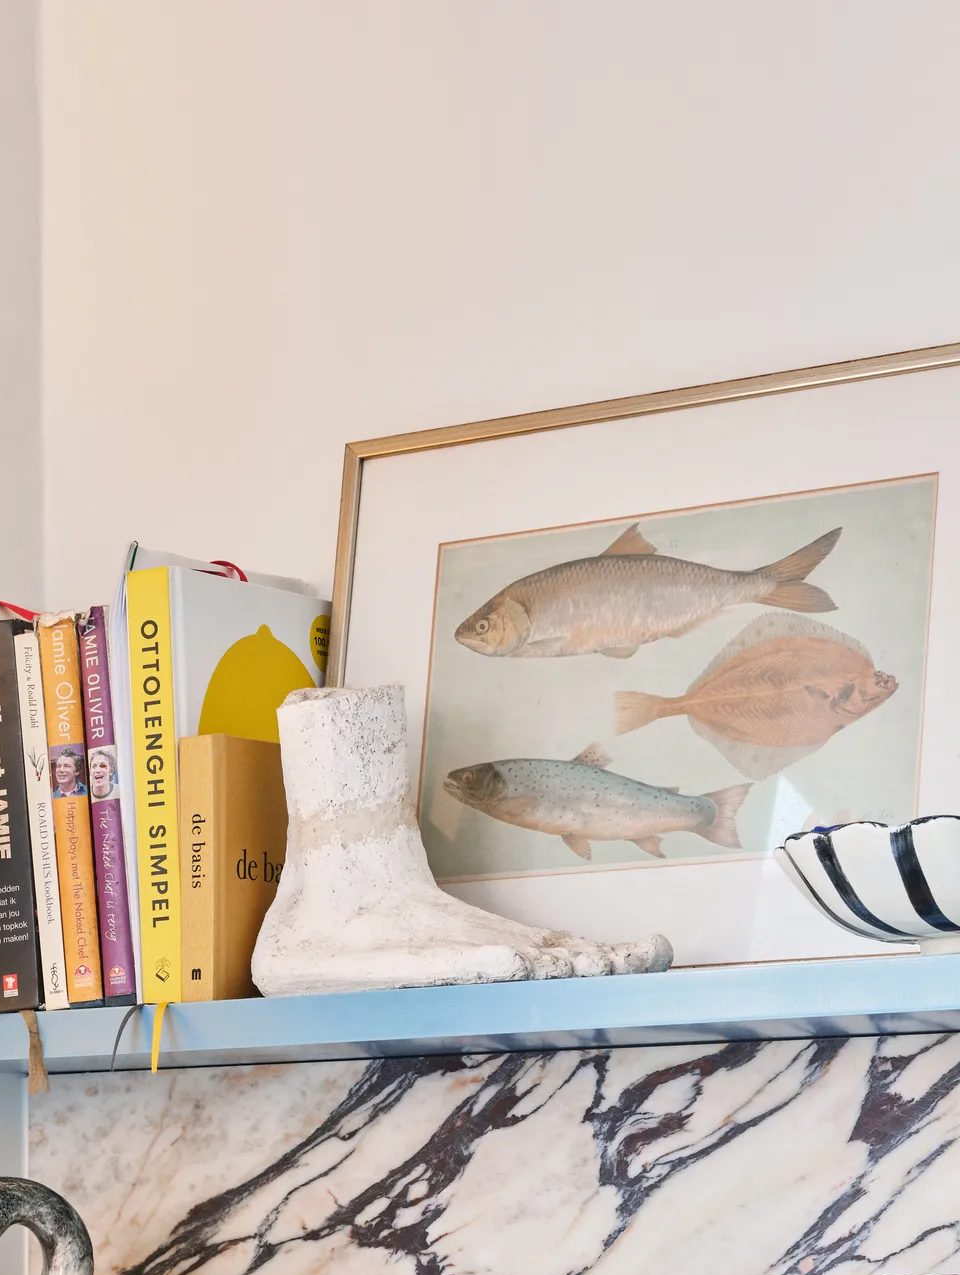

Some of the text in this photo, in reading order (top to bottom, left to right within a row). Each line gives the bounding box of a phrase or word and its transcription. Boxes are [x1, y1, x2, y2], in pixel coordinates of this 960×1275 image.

[23, 646, 32, 674] Felicity
[27, 684, 37, 707] Roald
[55, 681, 76, 741] Oliver
[87, 674, 105, 740] OLIVER
[29, 708, 39, 729] Dahl
[140, 620, 170, 928] OTTOLENGHI SIMPEL
[37, 802, 47, 839] ROALD
[44, 880, 56, 925] kookboek
[191, 813, 206, 889] de basis
[236, 849, 258, 881] de
[65, 802, 89, 959] Happy Days met The Naked Chef
[99, 809, 118, 942] The Naked Chef is terug
[8, 909, 20, 920] jou
[9, 896, 16, 905] ik
[2, 921, 28, 933] topkok
[3, 933, 29, 944] maken!
